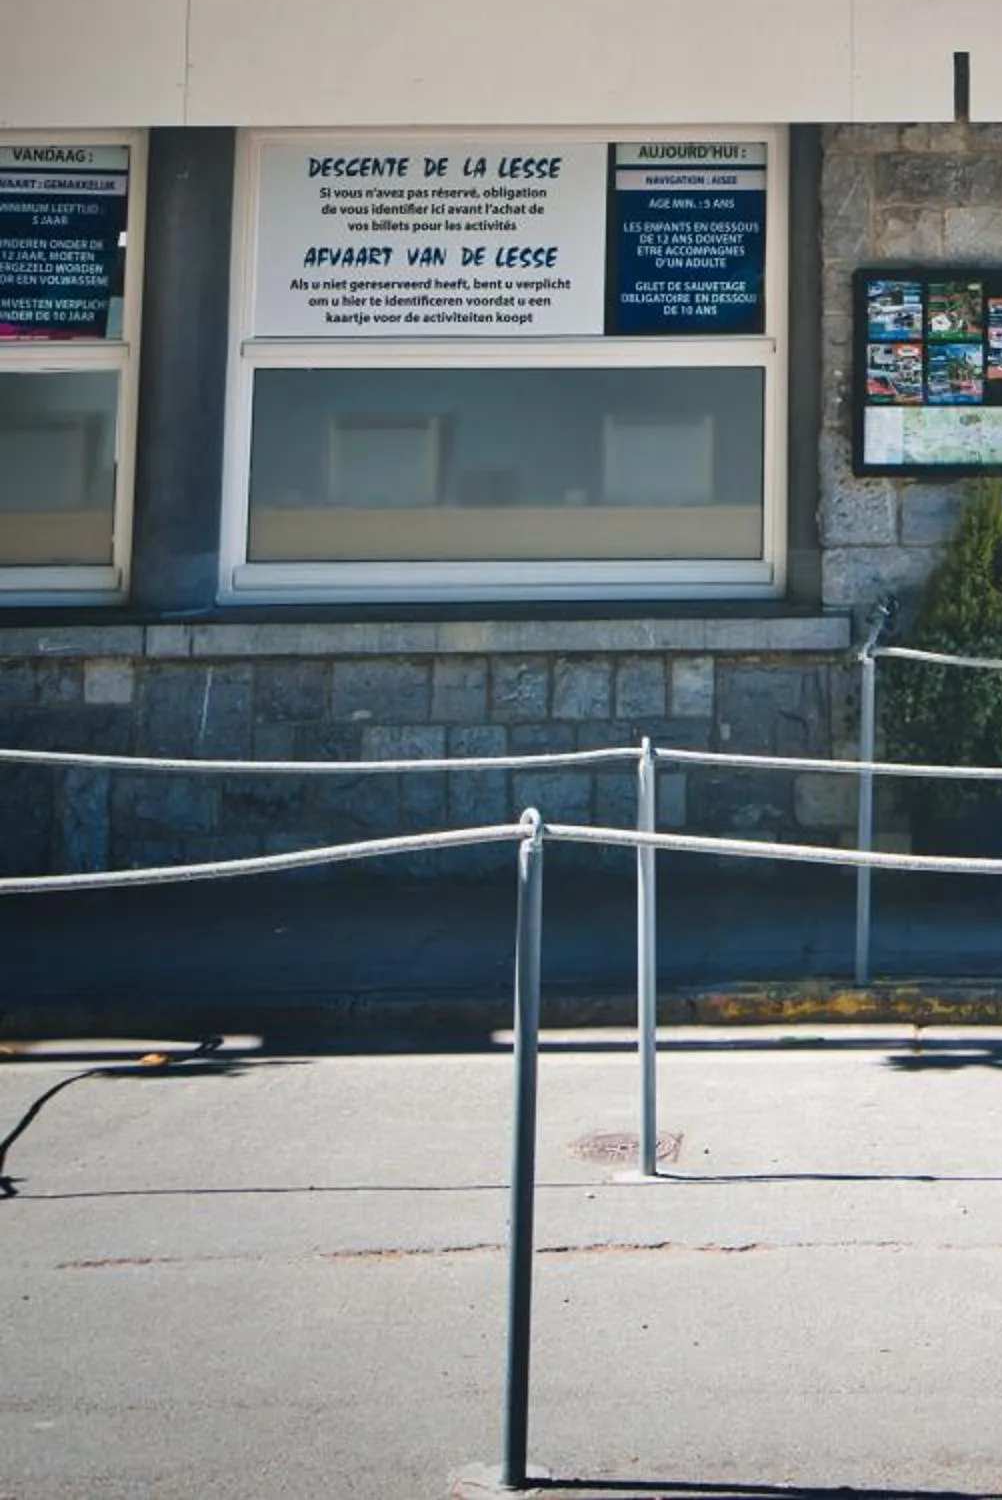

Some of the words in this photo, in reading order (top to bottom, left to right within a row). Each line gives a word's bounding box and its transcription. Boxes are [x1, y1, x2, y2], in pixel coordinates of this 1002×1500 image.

[13, 147, 86, 163] VANDAAG
[638, 145, 739, 159] AUJOURD'HUI
[308, 157, 409, 178] DESCENTE
[424, 157, 448, 177] DE
[463, 156, 486, 178] LA
[498, 156, 562, 179] LESSE
[645, 175, 704, 185] NAVIGATION
[320, 187, 331, 199] Si
[333, 189, 362, 199] vous
[366, 187, 404, 199] n'avez
[408, 189, 429, 200] pas
[483, 187, 547, 200] obligation
[321, 203, 337, 214] de
[340, 206, 369, 214] vous
[372, 203, 427, 214] identifier
[431, 203, 445, 214] ici
[448, 205, 482, 214] avant
[485, 203, 525, 214] l'achat
[528, 203, 545, 214] de
[713, 198, 735, 209] ANS
[40, 215, 69, 225] JAAR
[347, 222, 369, 231] vos
[372, 219, 409, 231] billets
[412, 222, 441, 233] pour
[445, 220, 462, 231] les
[464, 219, 517, 231] activités
[623, 221, 642, 233] LES
[644, 221, 692, 233] ENFANTS
[693, 221, 709, 233] EN
[640, 234, 655, 244] DE
[657, 234, 669, 244] 12
[671, 234, 693, 244] ANS
[695, 234, 744, 244] DOIVENT
[49, 240, 88, 250] ONDER
[49, 251, 95, 261] MOETEN
[304, 247, 393, 268] AFVAART
[408, 246, 447, 267] VAN
[462, 246, 486, 267] DE
[495, 246, 558, 268] LESSE
[637, 246, 662, 257] ETRE
[665, 246, 745, 257] ACCOMPAGNES
[655, 257, 683, 268] D'UN
[685, 257, 727, 268] ADULTE
[55, 263, 103, 274] WORDEN
[17, 275, 37, 285] EEN
[290, 278, 309, 290] Als
[312, 281, 320, 290] u
[323, 278, 347, 290] niet
[350, 278, 431, 292] gereserveerd
[473, 278, 502, 290] bent
[505, 281, 513, 289] u
[516, 278, 571, 292] verplicht
[635, 281, 665, 292] GILET
[667, 281, 682, 292] DE
[684, 281, 747, 292] SAUVETAGE
[308, 297, 328, 307] om
[331, 298, 339, 307] u
[342, 296, 367, 307] hier
[370, 296, 382, 307] te
[385, 296, 463, 307] identificeren
[466, 296, 515, 307] voordat
[518, 297, 525, 307] u
[528, 297, 551, 307] een
[621, 293, 690, 303] OBLIGATOIRE
[695, 293, 710, 303] EN
[35, 311, 49, 320] DE
[68, 311, 95, 321] JAAR
[663, 305, 677, 316] DE
[681, 305, 693, 316] 10
[695, 305, 717, 316] ANS
[326, 312, 370, 325] kaartje
[374, 315, 401, 323] voor
[405, 312, 421, 323] de
[424, 312, 493, 323] activiteiten
[496, 312, 533, 325] koopt
